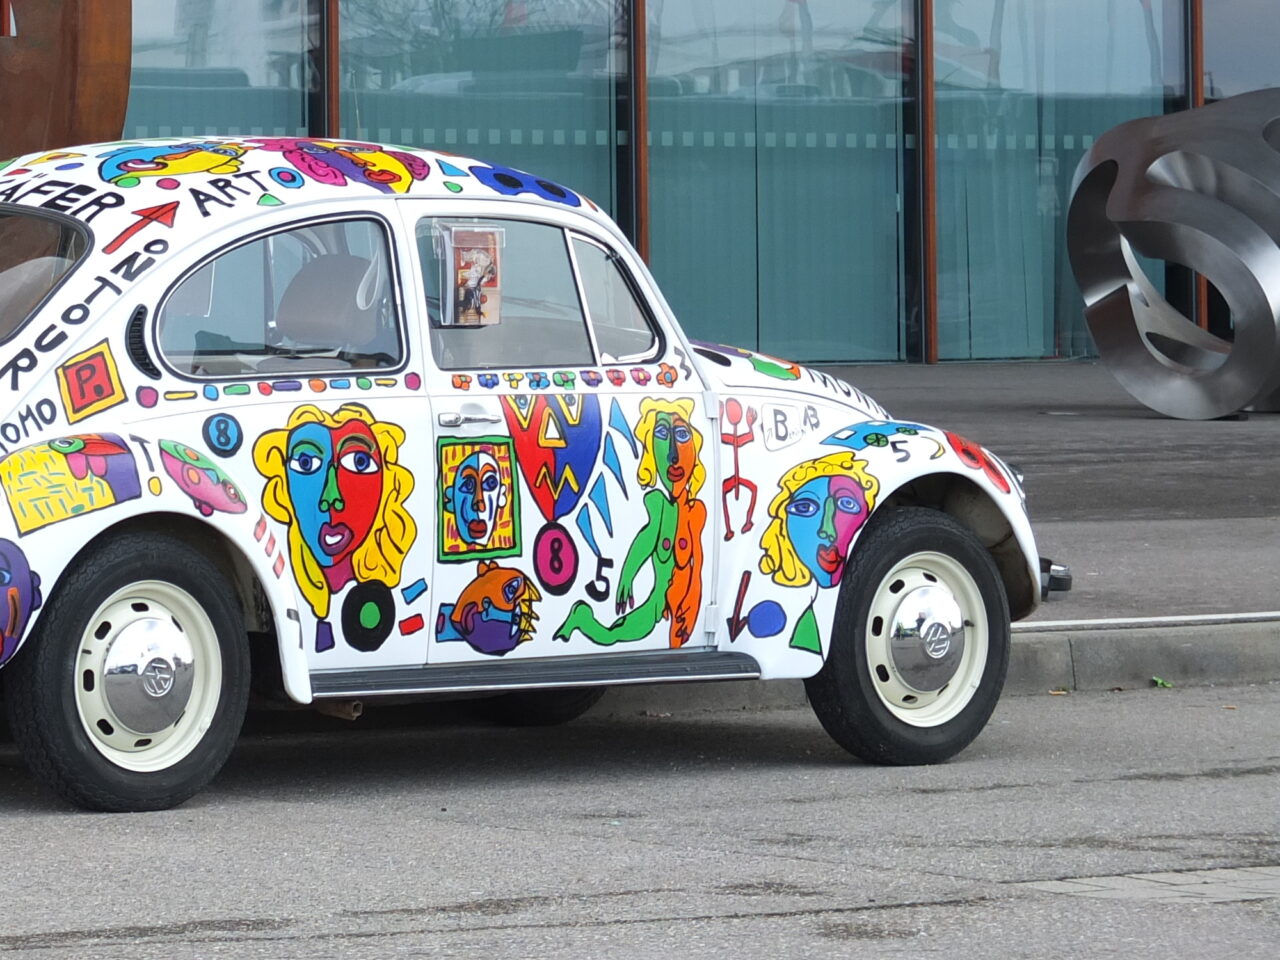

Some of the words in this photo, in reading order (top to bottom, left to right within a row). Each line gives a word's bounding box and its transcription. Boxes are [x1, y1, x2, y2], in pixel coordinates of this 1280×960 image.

[188, 170, 270, 217] ART
[890, 440, 912, 463] 5
[584, 556, 614, 602] 5
